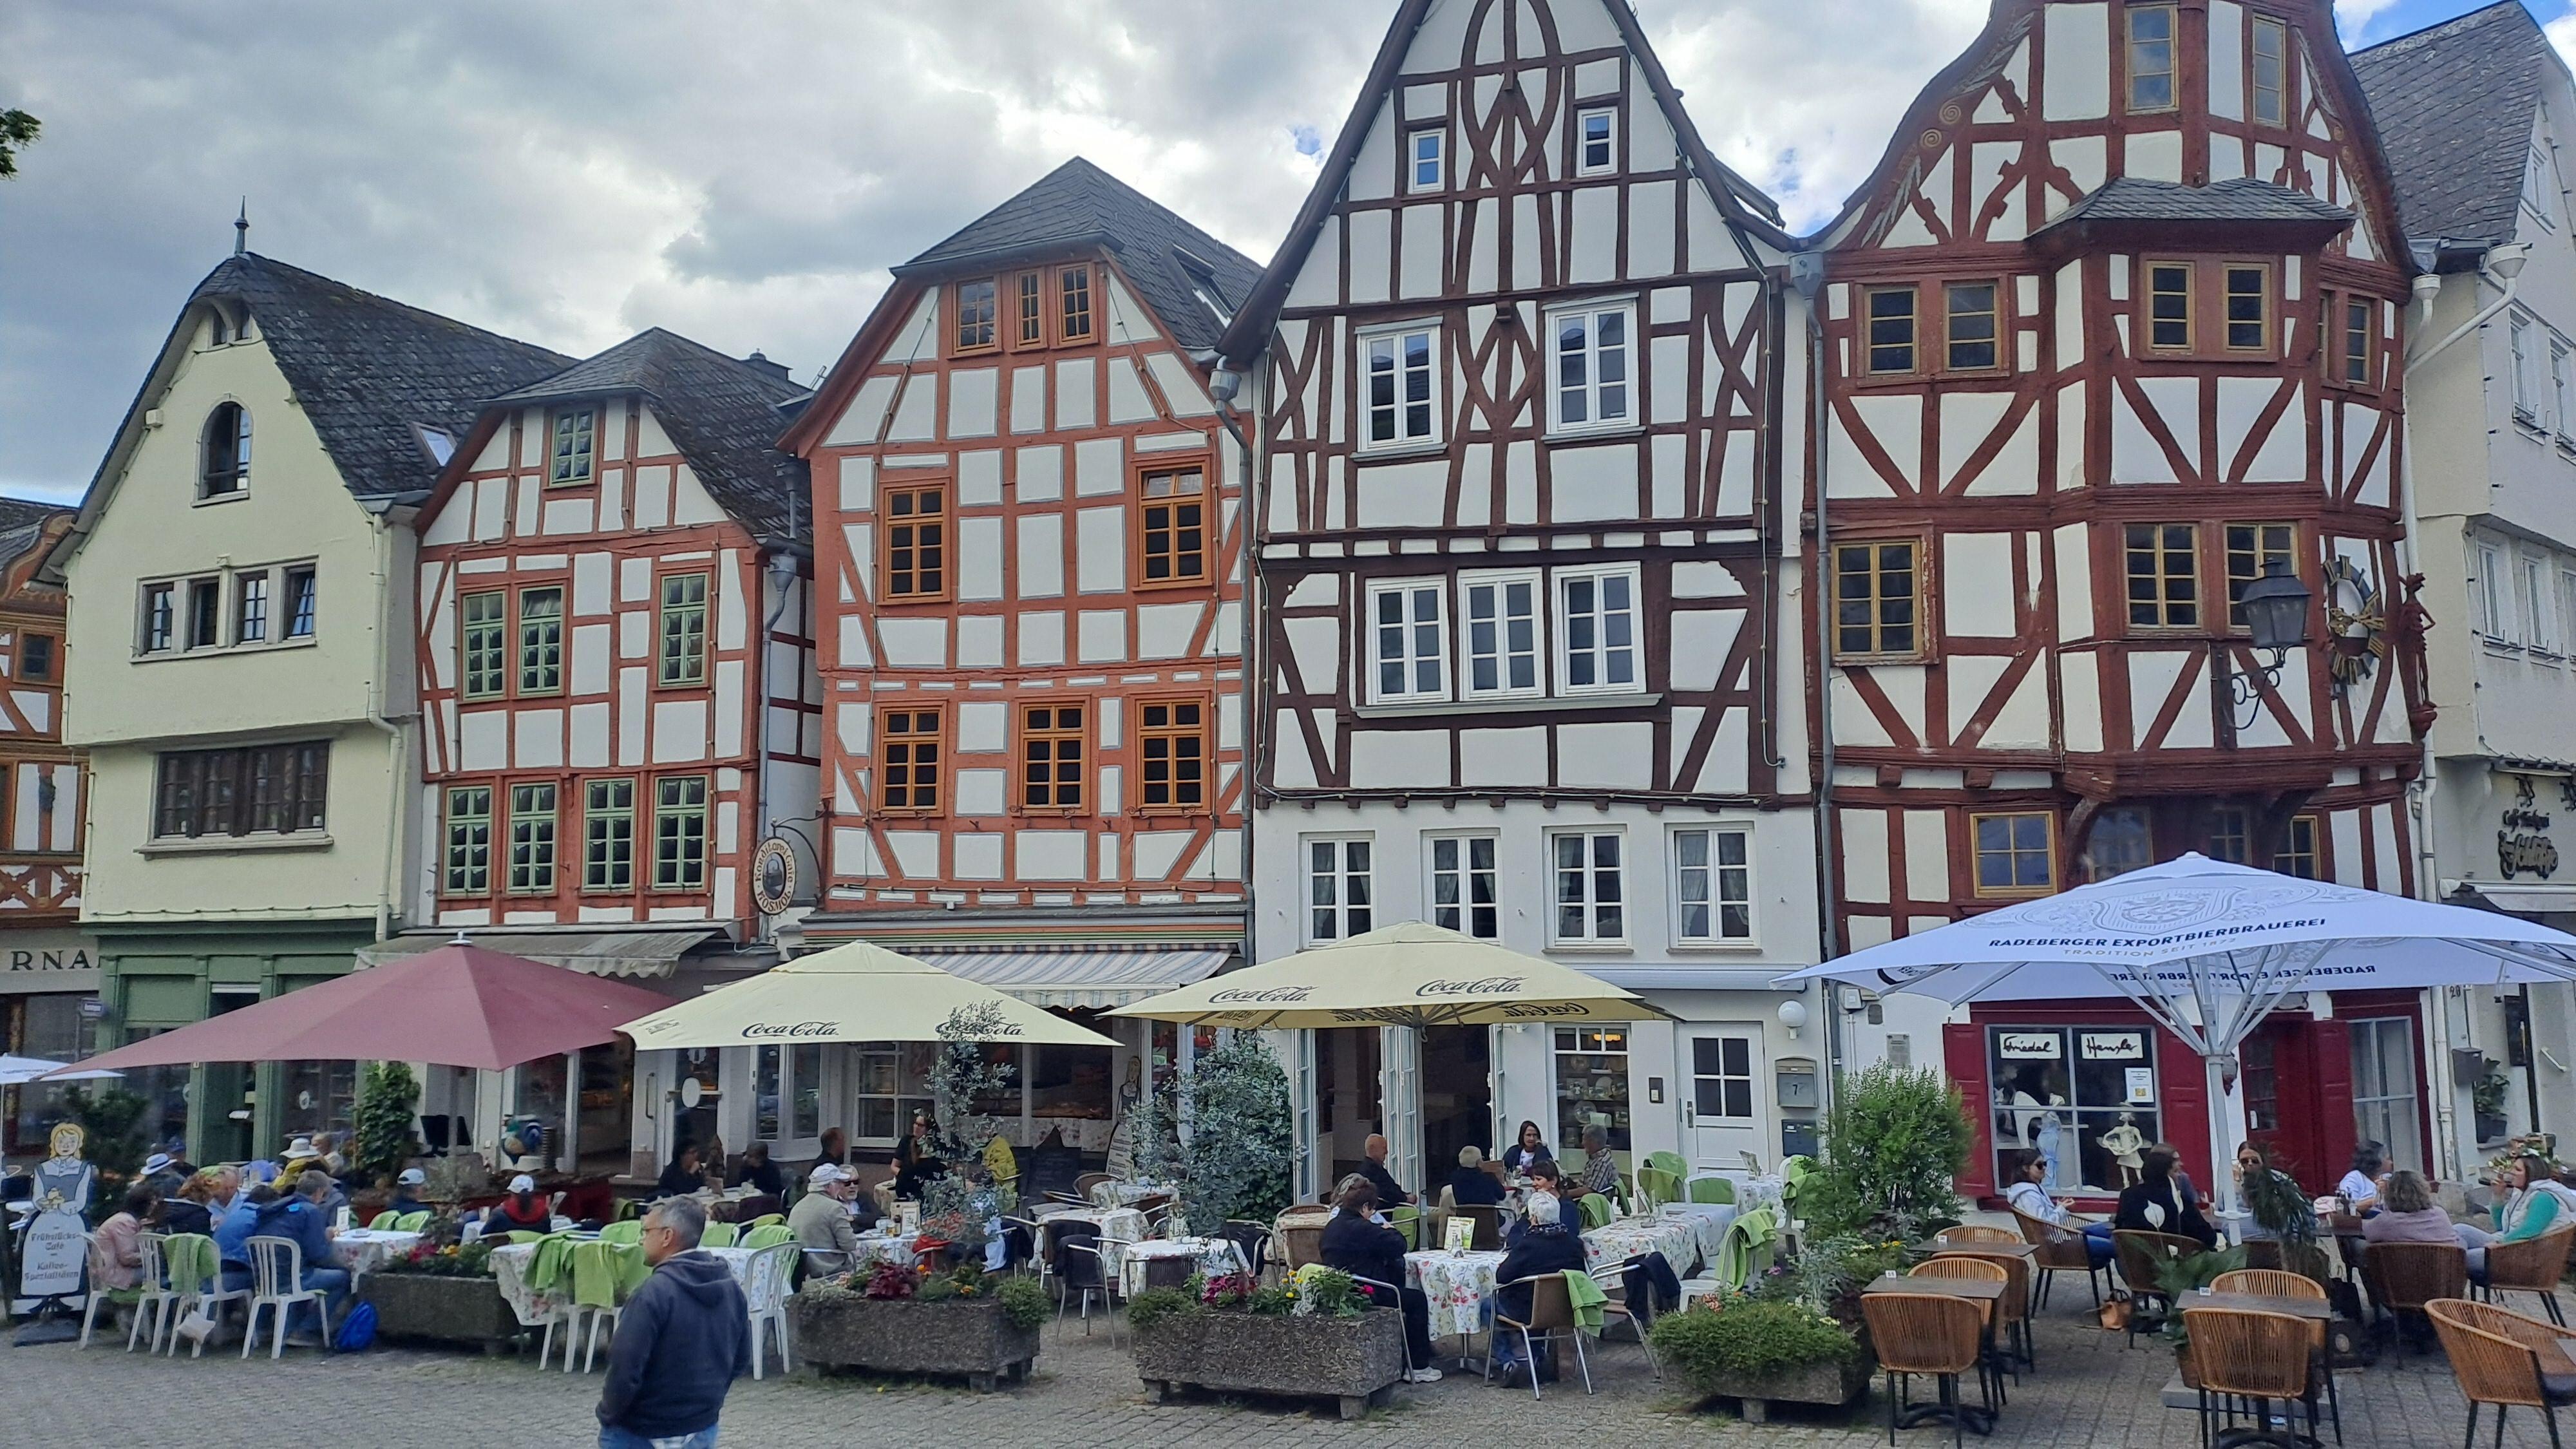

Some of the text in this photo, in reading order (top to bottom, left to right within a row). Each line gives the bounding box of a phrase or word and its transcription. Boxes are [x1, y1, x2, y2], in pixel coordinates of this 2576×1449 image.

[1989, 918, 2326, 947] RADEBERGER EXPORTBIERBRAUEREI
[2161, 944, 2196, 954] SEIT
[1208, 986, 1320, 1003] Coca-Cola
[1416, 976, 1529, 997] Coca-Cola
[742, 1022, 840, 1038] Coca-Cola
[2003, 1036, 2053, 1052] Friedel
[1792, 1084, 1798, 1095] 7
